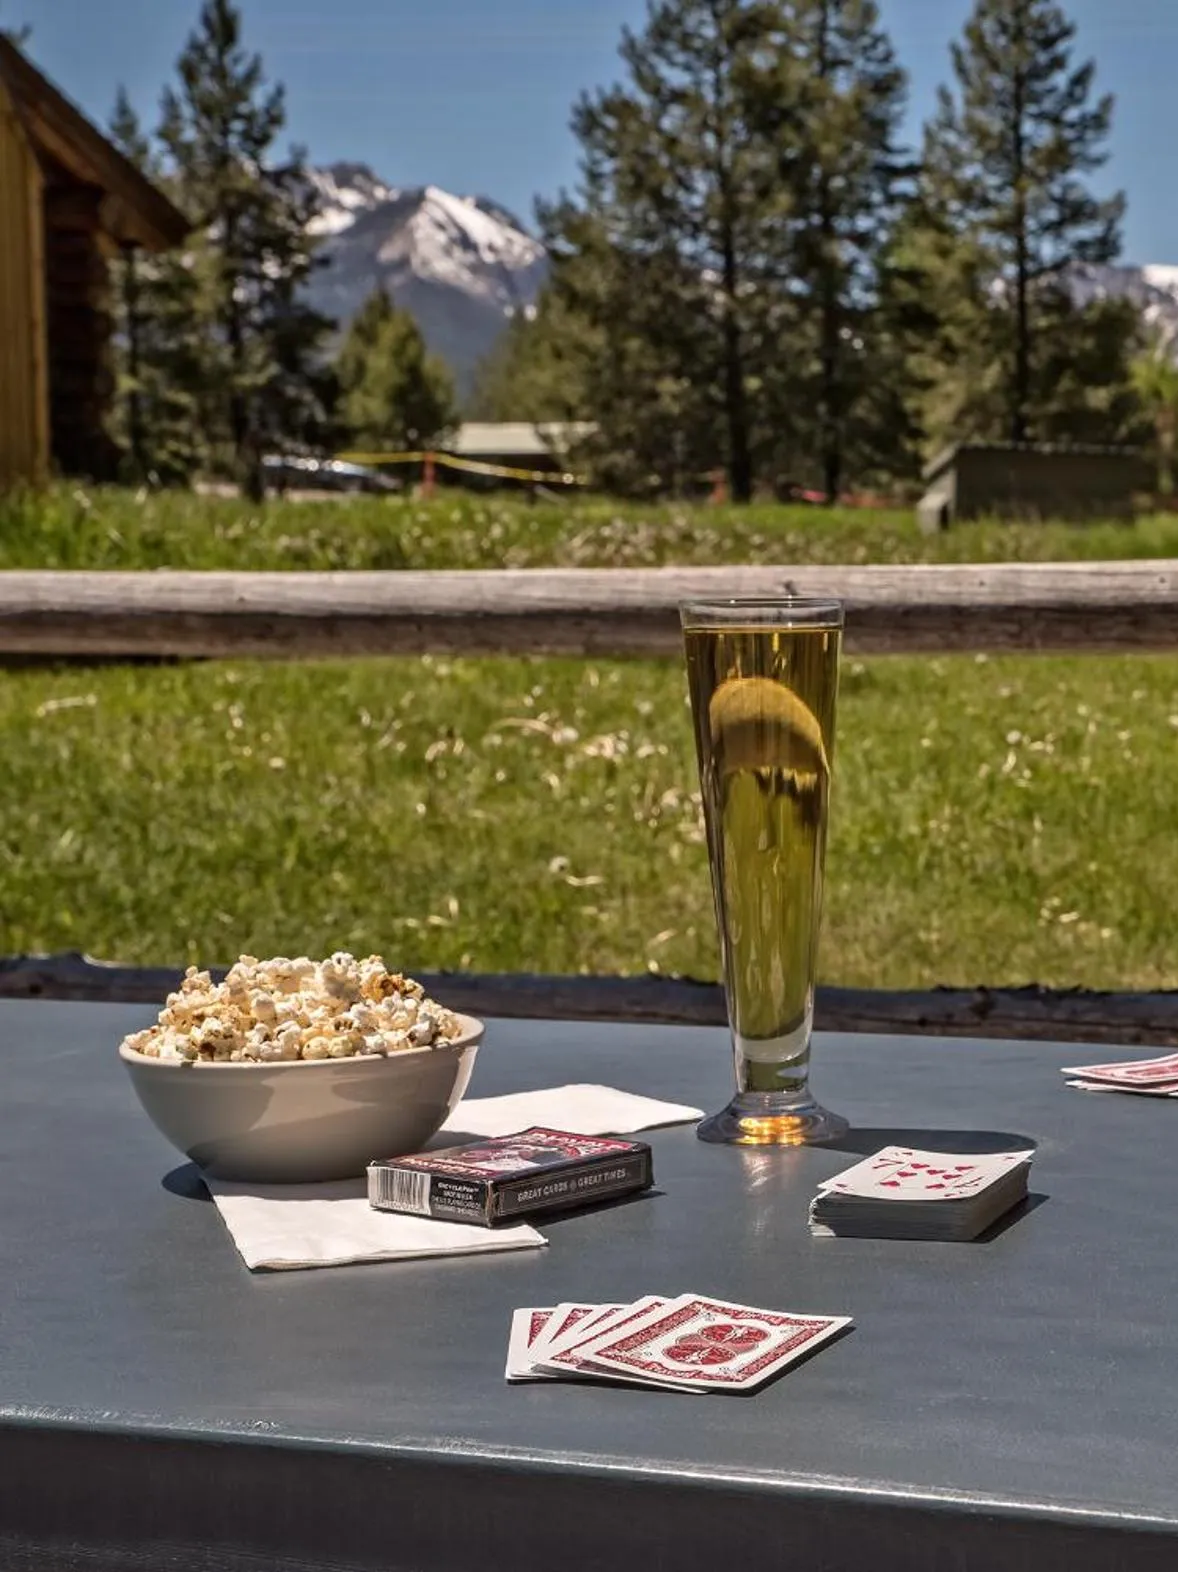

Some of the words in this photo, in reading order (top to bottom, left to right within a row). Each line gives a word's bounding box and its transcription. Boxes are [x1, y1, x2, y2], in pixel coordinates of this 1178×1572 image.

[517, 1188, 542, 1202] GREAT
[543, 1181, 568, 1196] CARDS
[578, 1174, 603, 1187] GREAT
[604, 1168, 626, 1181] TIMES
